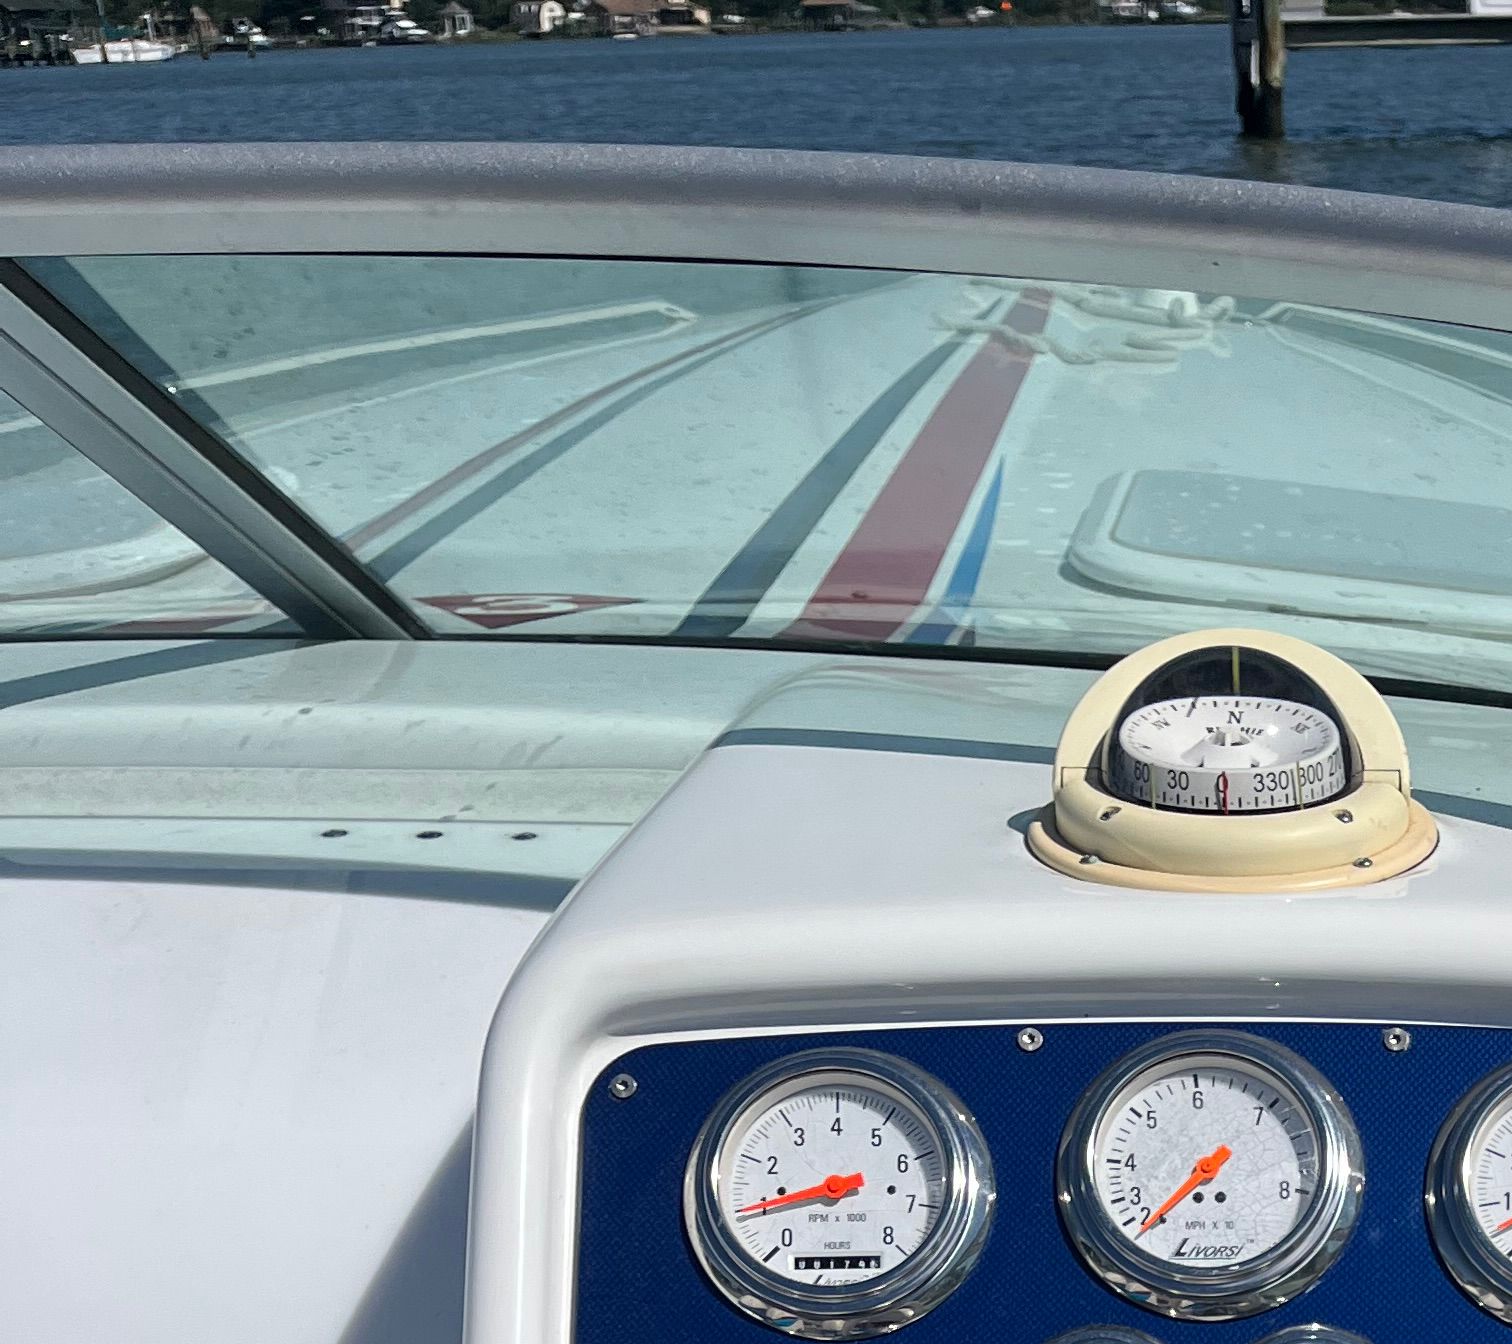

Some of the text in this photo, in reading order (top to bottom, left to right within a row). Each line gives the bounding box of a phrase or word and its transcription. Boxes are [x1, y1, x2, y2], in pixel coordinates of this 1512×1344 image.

[1228, 711, 1244, 724] N
[1134, 761, 1323, 792] 60 30 330 300
[1193, 1091, 1203, 1109] 6
[831, 1118, 843, 1135] 4
[1147, 1107, 1264, 1128] 5 7
[794, 1128, 882, 1146] 3 5
[768, 1155, 908, 1175] 2 6
[1125, 1153, 1136, 1171] 4
[1131, 1187, 1141, 1204] 3
[1279, 1181, 1290, 1199] 8
[906, 1195, 915, 1212] 7
[808, 1213, 866, 1222] RPM 1000
[1186, 1221, 1205, 1229] MPH
[1225, 1221, 1233, 1229] 10
[781, 1227, 894, 1246] 0 8
[824, 1241, 850, 1249] HOURS
